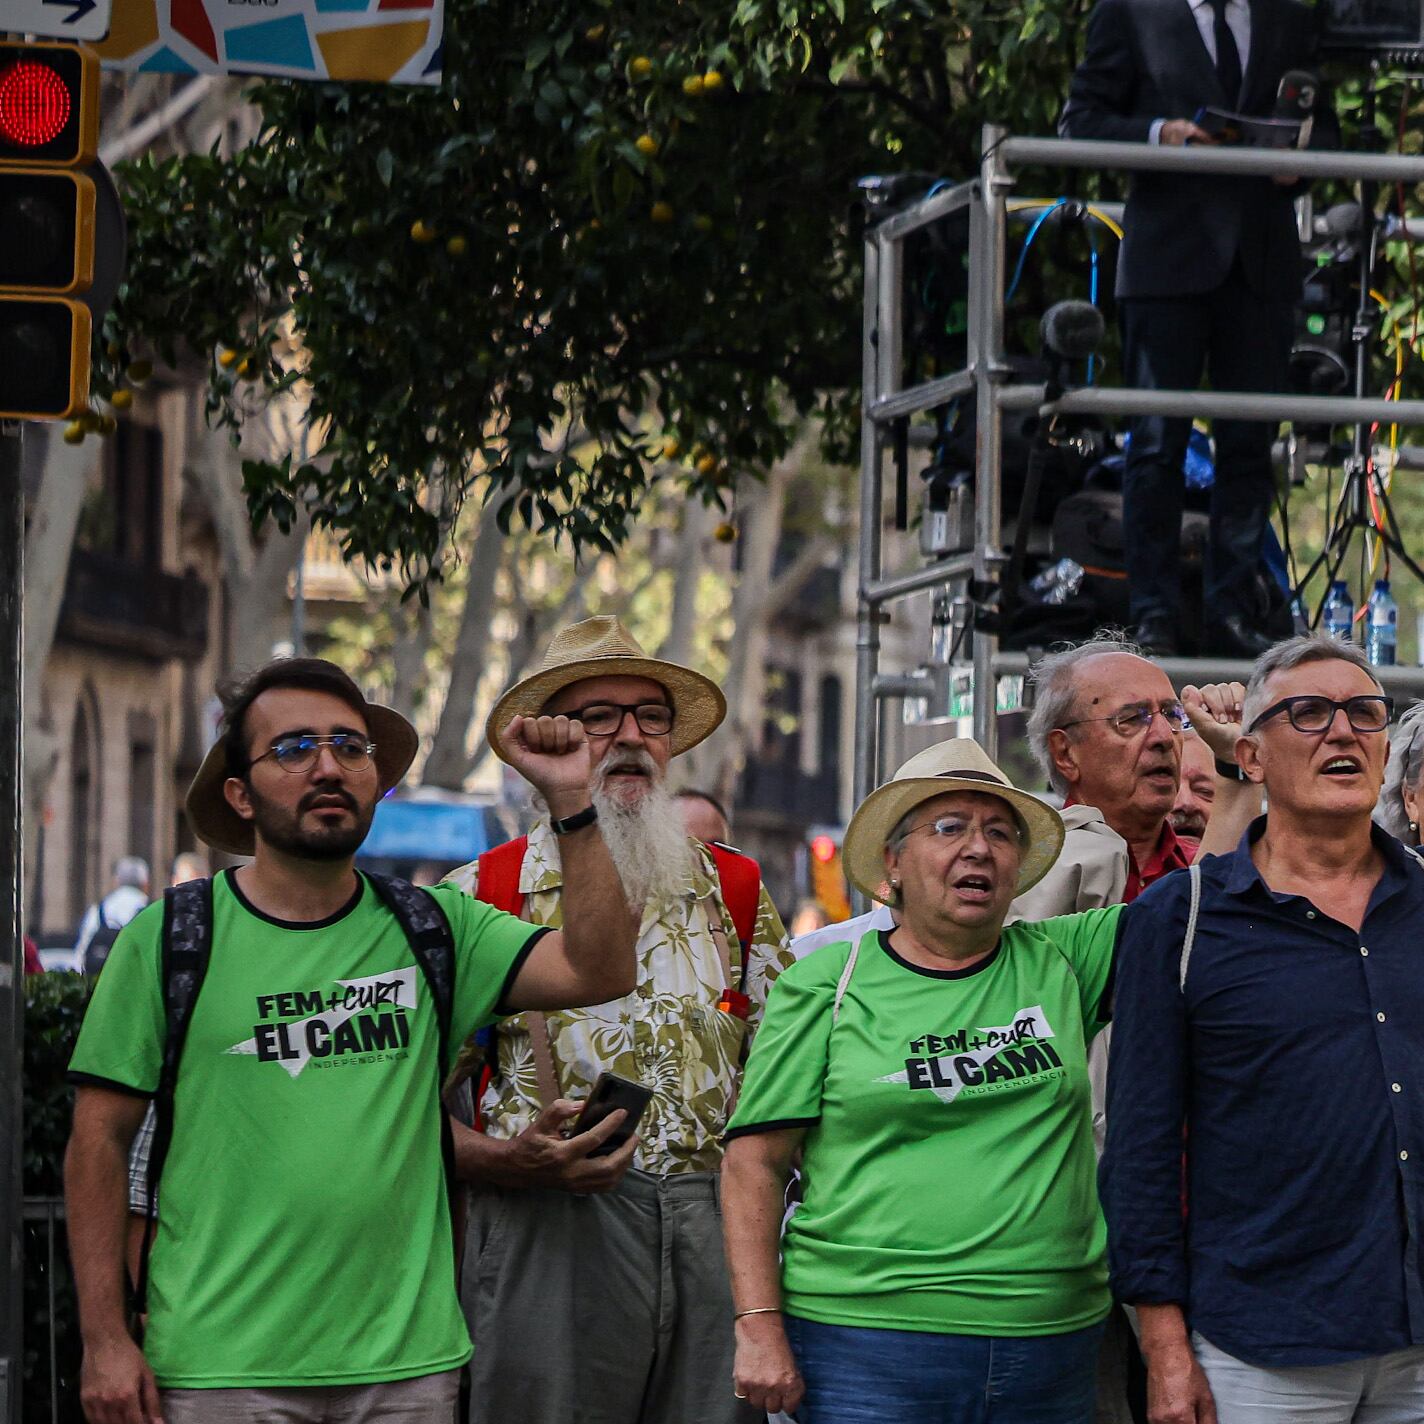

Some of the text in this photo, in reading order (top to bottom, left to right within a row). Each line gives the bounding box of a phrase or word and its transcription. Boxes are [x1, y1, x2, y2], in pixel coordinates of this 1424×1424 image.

[255, 990, 324, 1019] FEM
[253, 1008, 410, 1063] EL CAMÍ
[909, 1029, 969, 1054] FEM
[904, 1038, 1064, 1091] EL CAMÍ
